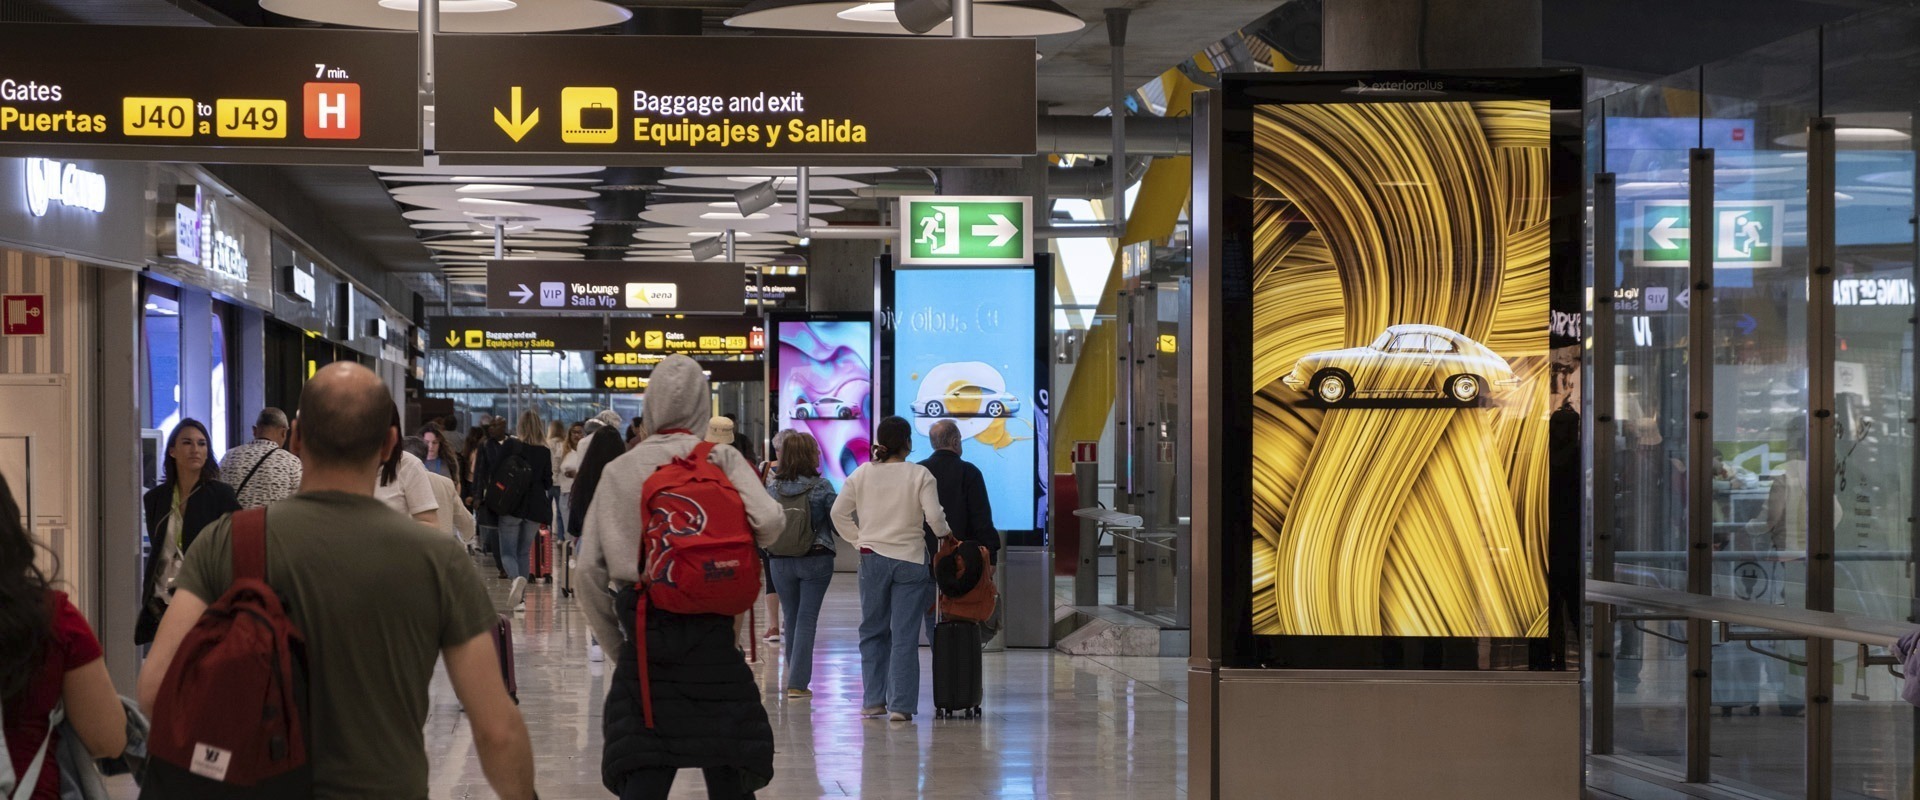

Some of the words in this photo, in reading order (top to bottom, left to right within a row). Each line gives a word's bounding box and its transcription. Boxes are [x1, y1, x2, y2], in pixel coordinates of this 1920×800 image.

[315, 63, 325, 78] 7
[327, 67, 349, 79] min.
[1, 79, 62, 101] Gates
[1372, 80, 1444, 92] exteriorplus
[197, 102, 212, 116] to
[633, 90, 724, 115] Baggage
[729, 92, 764, 112] and
[768, 91, 804, 112] exit
[132, 105, 185, 129] J40
[318, 92, 346, 129] H
[1, 107, 107, 133] Puertas
[225, 107, 278, 130] J49
[199, 120, 211, 134] a
[633, 118, 760, 146] Equipajes
[766, 124, 781, 148] y
[788, 118, 867, 143] Salida
[543, 289, 562, 299] VIP
[571, 283, 586, 296] Vip
[587, 283, 620, 296] Lounge
[571, 295, 596, 306] Sala
[598, 295, 617, 308] Vip
[485, 331, 513, 340] Baggage
[665, 332, 684, 340] Gates
[753, 334, 763, 346] H
[485, 339, 523, 348] Equipajes
[531, 339, 555, 348] Salida
[665, 340, 697, 349] Puertas
[703, 339, 718, 347] J40
[728, 339, 744, 347] J49
